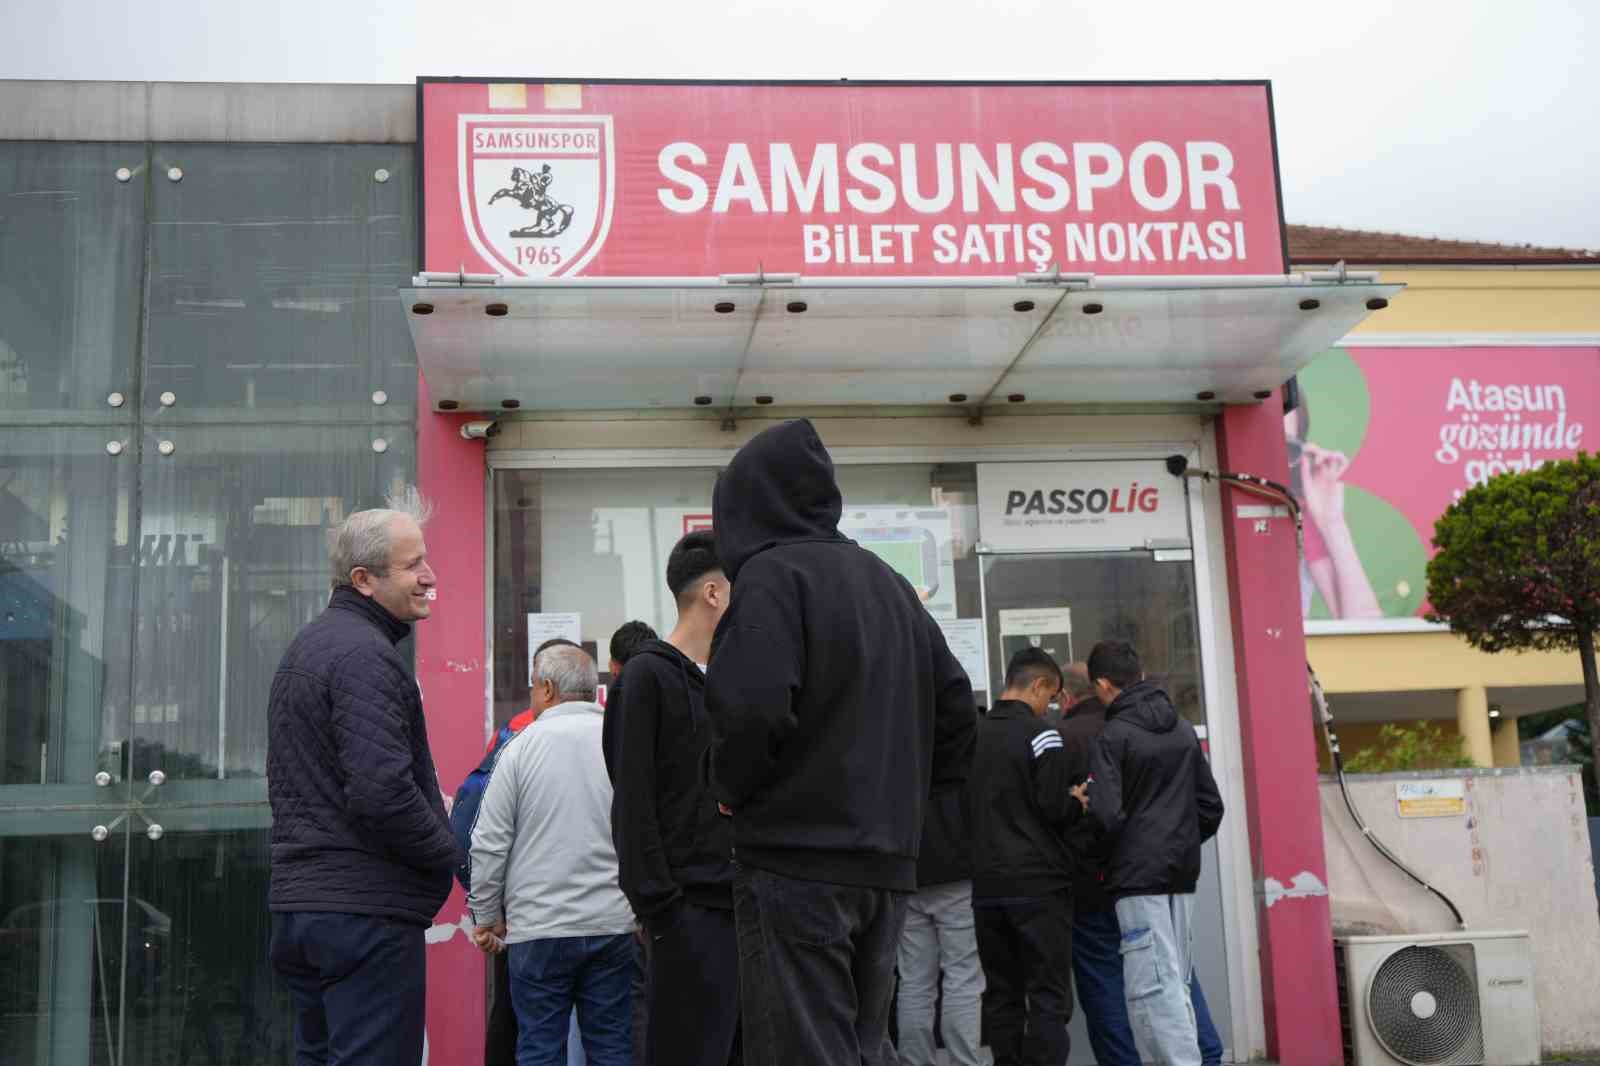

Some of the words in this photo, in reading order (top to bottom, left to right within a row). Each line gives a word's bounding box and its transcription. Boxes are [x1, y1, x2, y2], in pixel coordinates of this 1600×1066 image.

[475, 132, 597, 149] SAMSUNSPOR
[657, 140, 1241, 215] SAMSUNSPOR
[514, 246, 562, 265] 1965
[932, 222, 1055, 273] SATIŞ
[1065, 220, 1247, 263] NOKTASI
[1446, 377, 1566, 413] Atasun
[1435, 411, 1584, 465] gözünde
